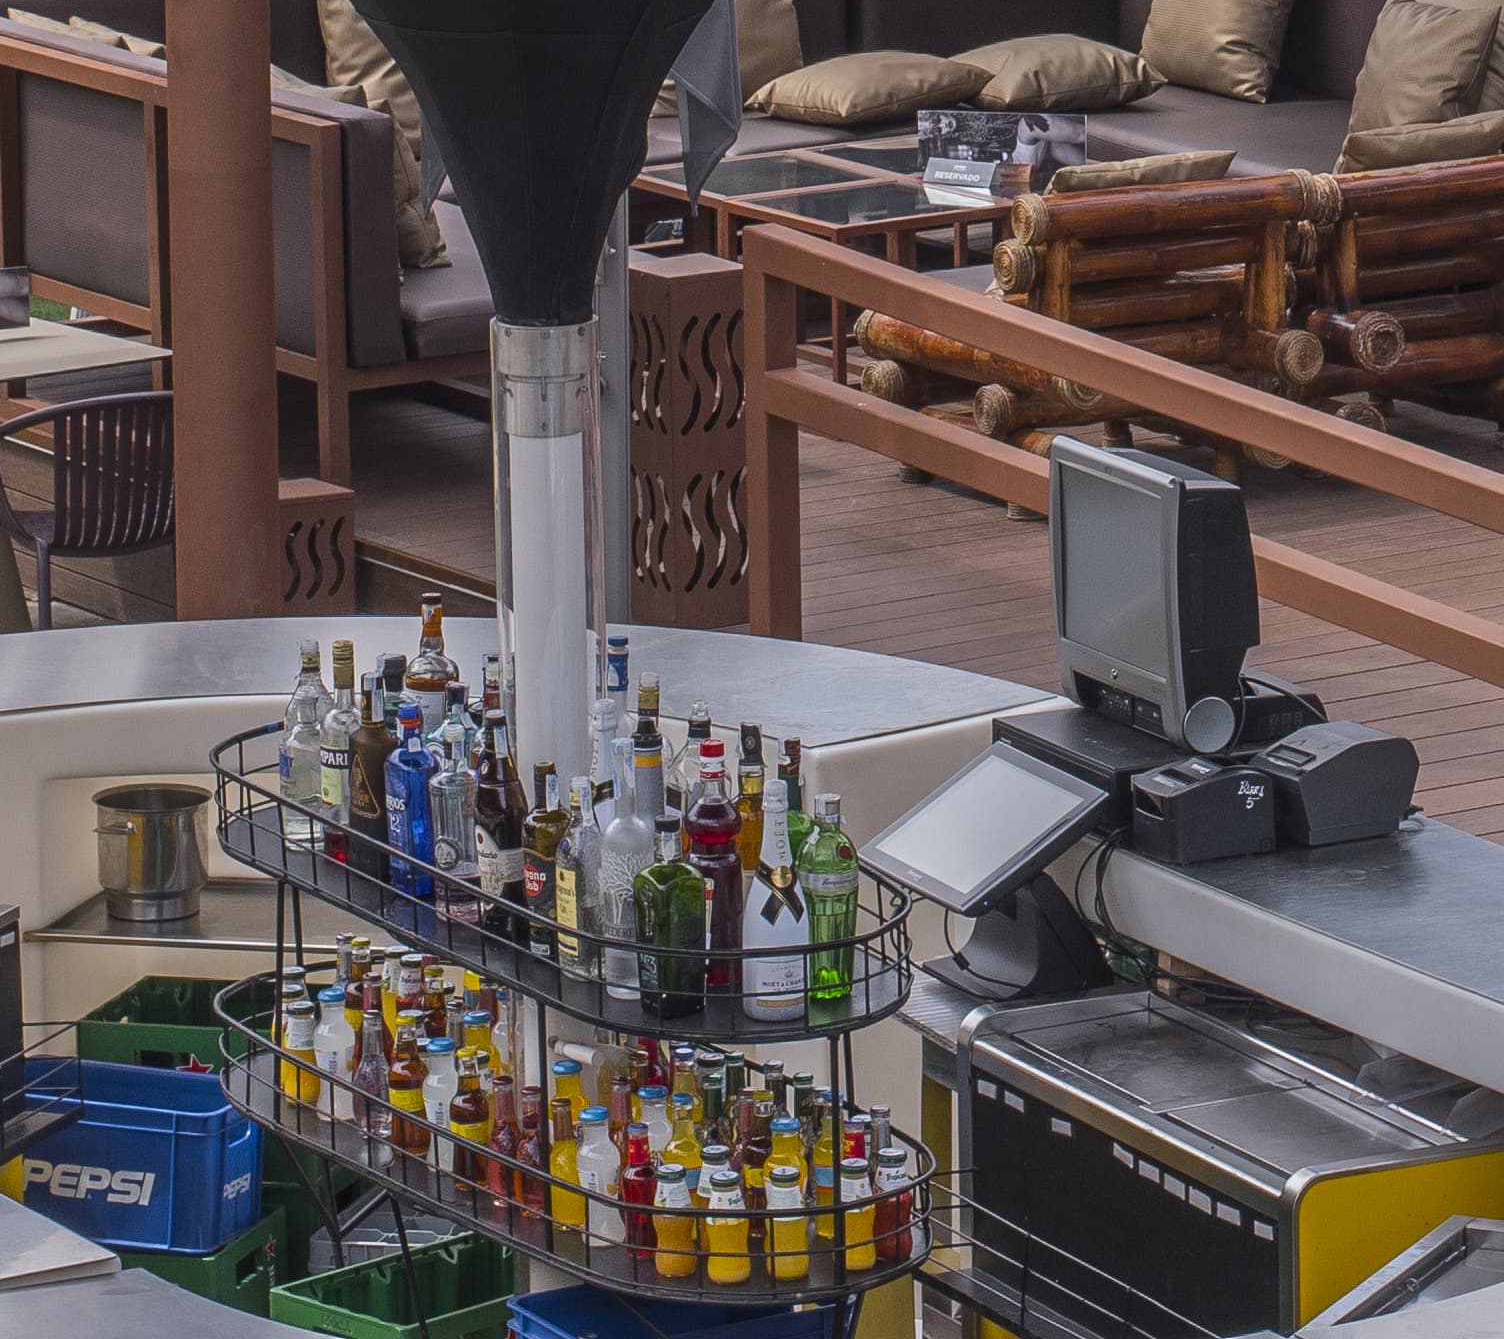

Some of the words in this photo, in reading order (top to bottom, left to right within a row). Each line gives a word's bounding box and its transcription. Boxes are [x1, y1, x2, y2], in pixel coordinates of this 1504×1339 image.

[934, 170, 981, 183] RESERVADO
[1246, 797, 1261, 810] 5
[23, 1157, 156, 1206] PEPSI
[223, 1171, 252, 1200] PEPSI
